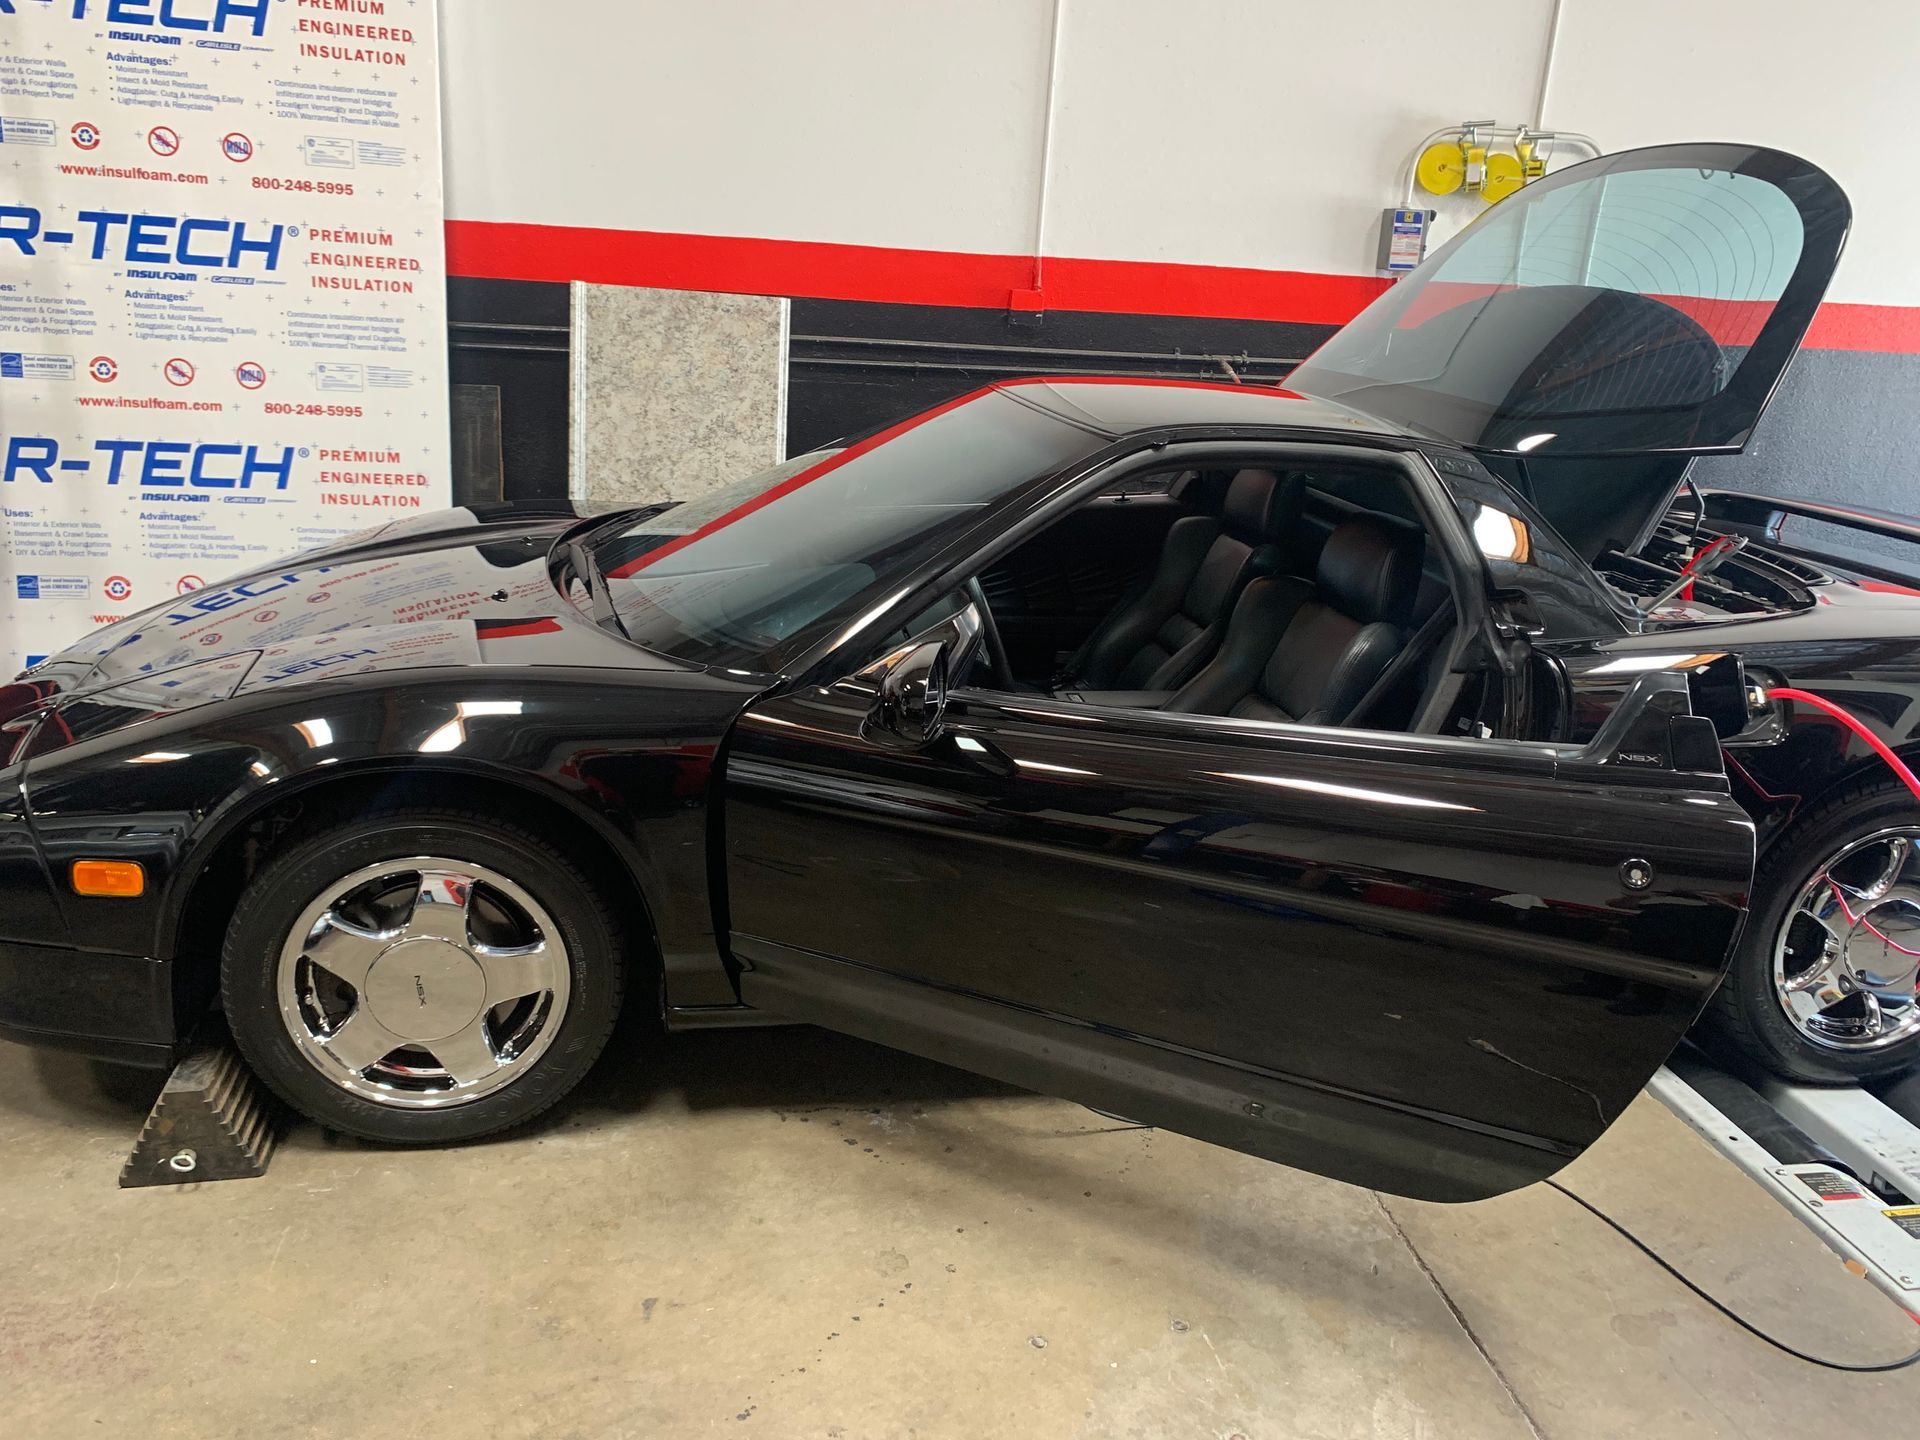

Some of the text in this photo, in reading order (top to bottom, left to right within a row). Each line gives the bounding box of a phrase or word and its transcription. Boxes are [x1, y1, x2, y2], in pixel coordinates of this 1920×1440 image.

[298, 0, 384, 15] PREMIUM
[0, 0, 269, 37] ECH
[299, 19, 412, 42] ENGINEERED
[107, 52, 172, 66] Advantages:
[300, 44, 406, 66] INSULATION
[61, 164, 208, 184] www.insulfoam.com
[252, 177, 354, 196] 800-248-5995
[310, 229, 393, 246] PREMIUM
[311, 252, 419, 270] ENGINEERED
[312, 276, 413, 293] INSULATION
[125, 290, 189, 302] Advantages:
[79, 397, 223, 411] www.insulfoam.com
[264, 403, 363, 417] 800-248-5995
[320, 449, 400, 463] PREMIUM
[320, 472, 427, 486] ENGINEERED
[321, 493, 420, 507] INSULATION
[4, 509, 33, 517] Uses:
[139, 512, 201, 522] Advantages:
[1619, 754, 1658, 762] NSX
[414, 975, 427, 1006] NSX
